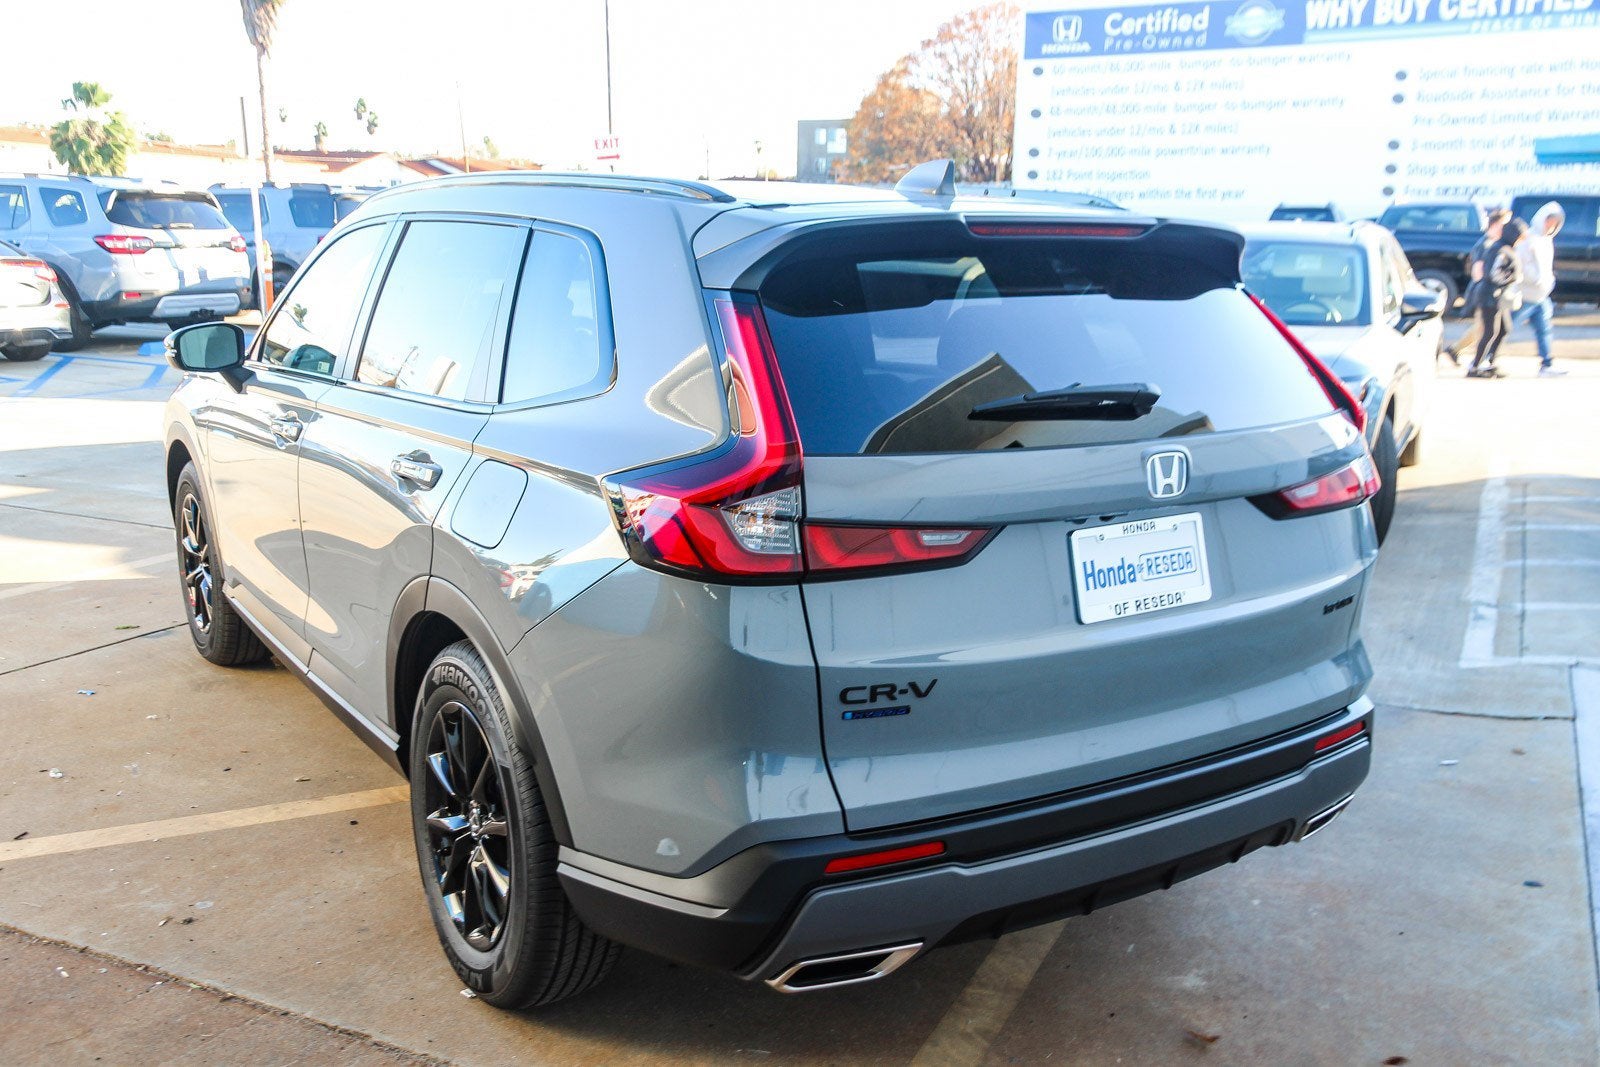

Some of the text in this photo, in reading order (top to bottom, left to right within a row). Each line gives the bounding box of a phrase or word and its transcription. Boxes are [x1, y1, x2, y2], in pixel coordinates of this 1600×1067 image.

[1103, 5, 1210, 37] Certified
[1305, 0, 1367, 30] WHY
[1372, 0, 1430, 25] BUY
[1558, 11, 1600, 30] MIN
[1103, 32, 1208, 52] Pre-Owned
[1549, 59, 1574, 73] with
[1479, 86, 1551, 101] Assistance
[1556, 82, 1575, 98] for
[594, 137, 619, 150] EXIT
[1122, 520, 1157, 535] HONDA
[1083, 556, 1137, 592] Honda
[1146, 551, 1194, 577] RESEDA
[1114, 591, 1184, 616] OF RESEDA
[839, 678, 938, 705] CR-V
